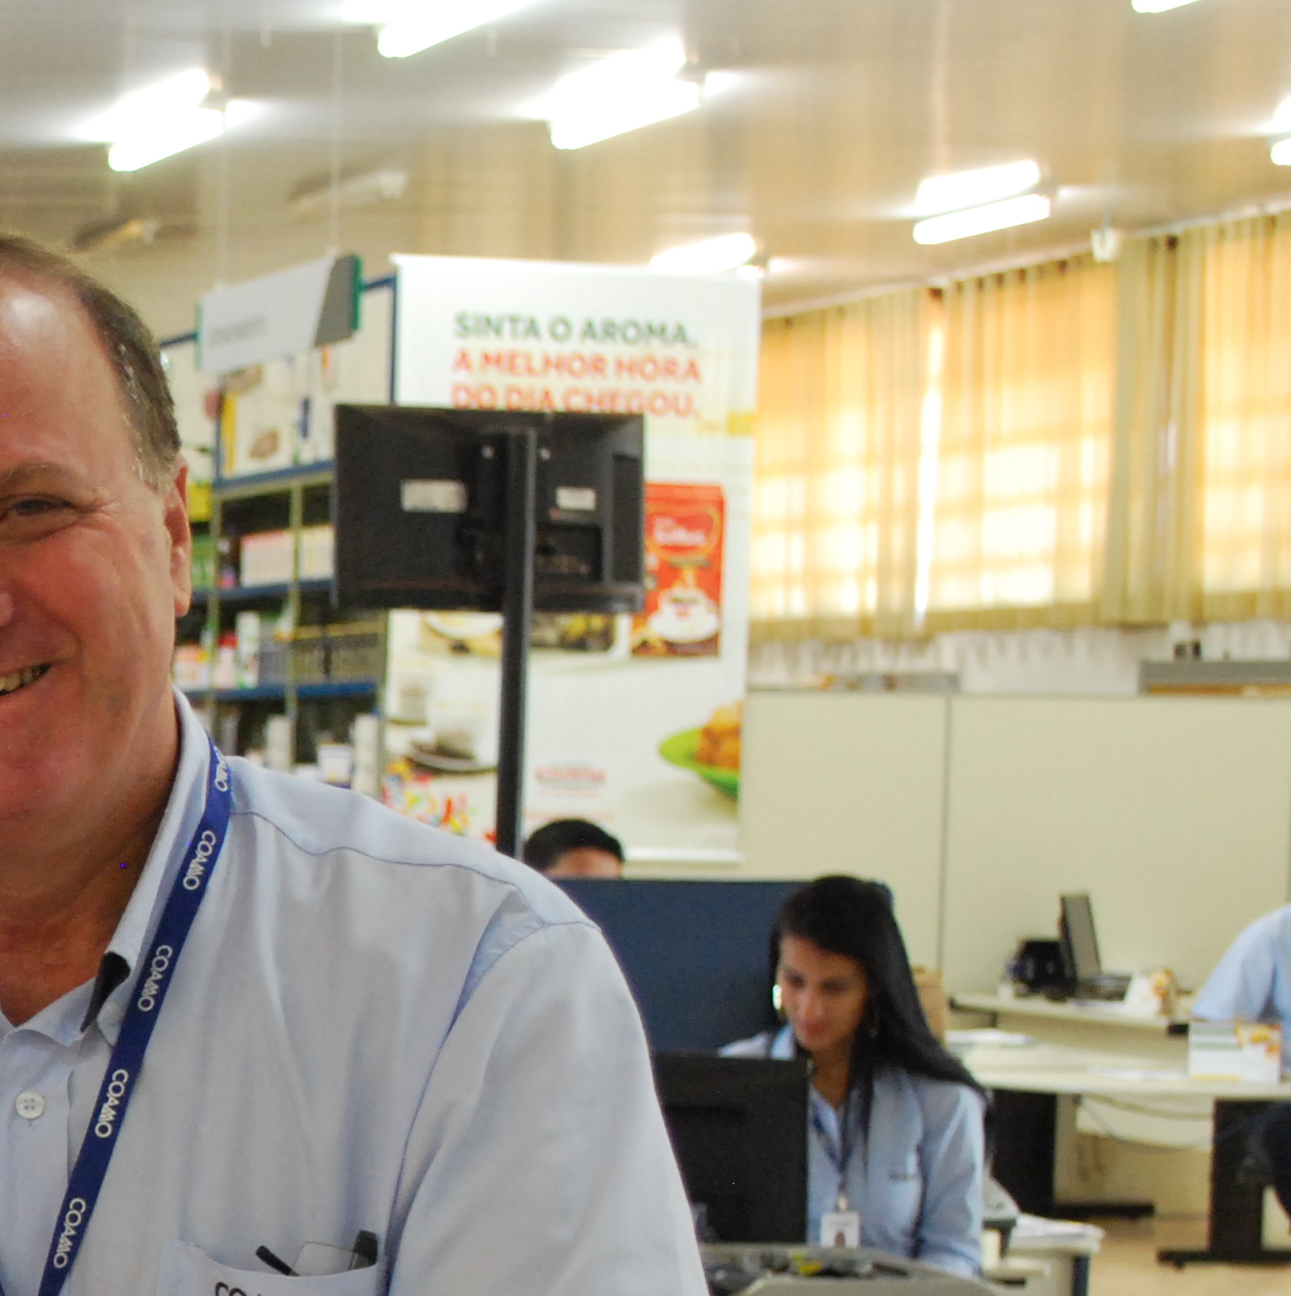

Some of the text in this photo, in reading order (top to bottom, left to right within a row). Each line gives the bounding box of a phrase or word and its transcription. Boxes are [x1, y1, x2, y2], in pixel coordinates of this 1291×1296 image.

[453, 309, 541, 342] SINTA
[547, 314, 573, 342] O
[452, 347, 703, 384] A MELHOR HORA
[451, 383, 498, 410] DO
[504, 384, 555, 412] DIA
[182, 830, 217, 891] COAMO
[137, 944, 174, 1013] COAMO
[94, 1068, 129, 1139] COAMO
[53, 1197, 86, 1270] COAMO
